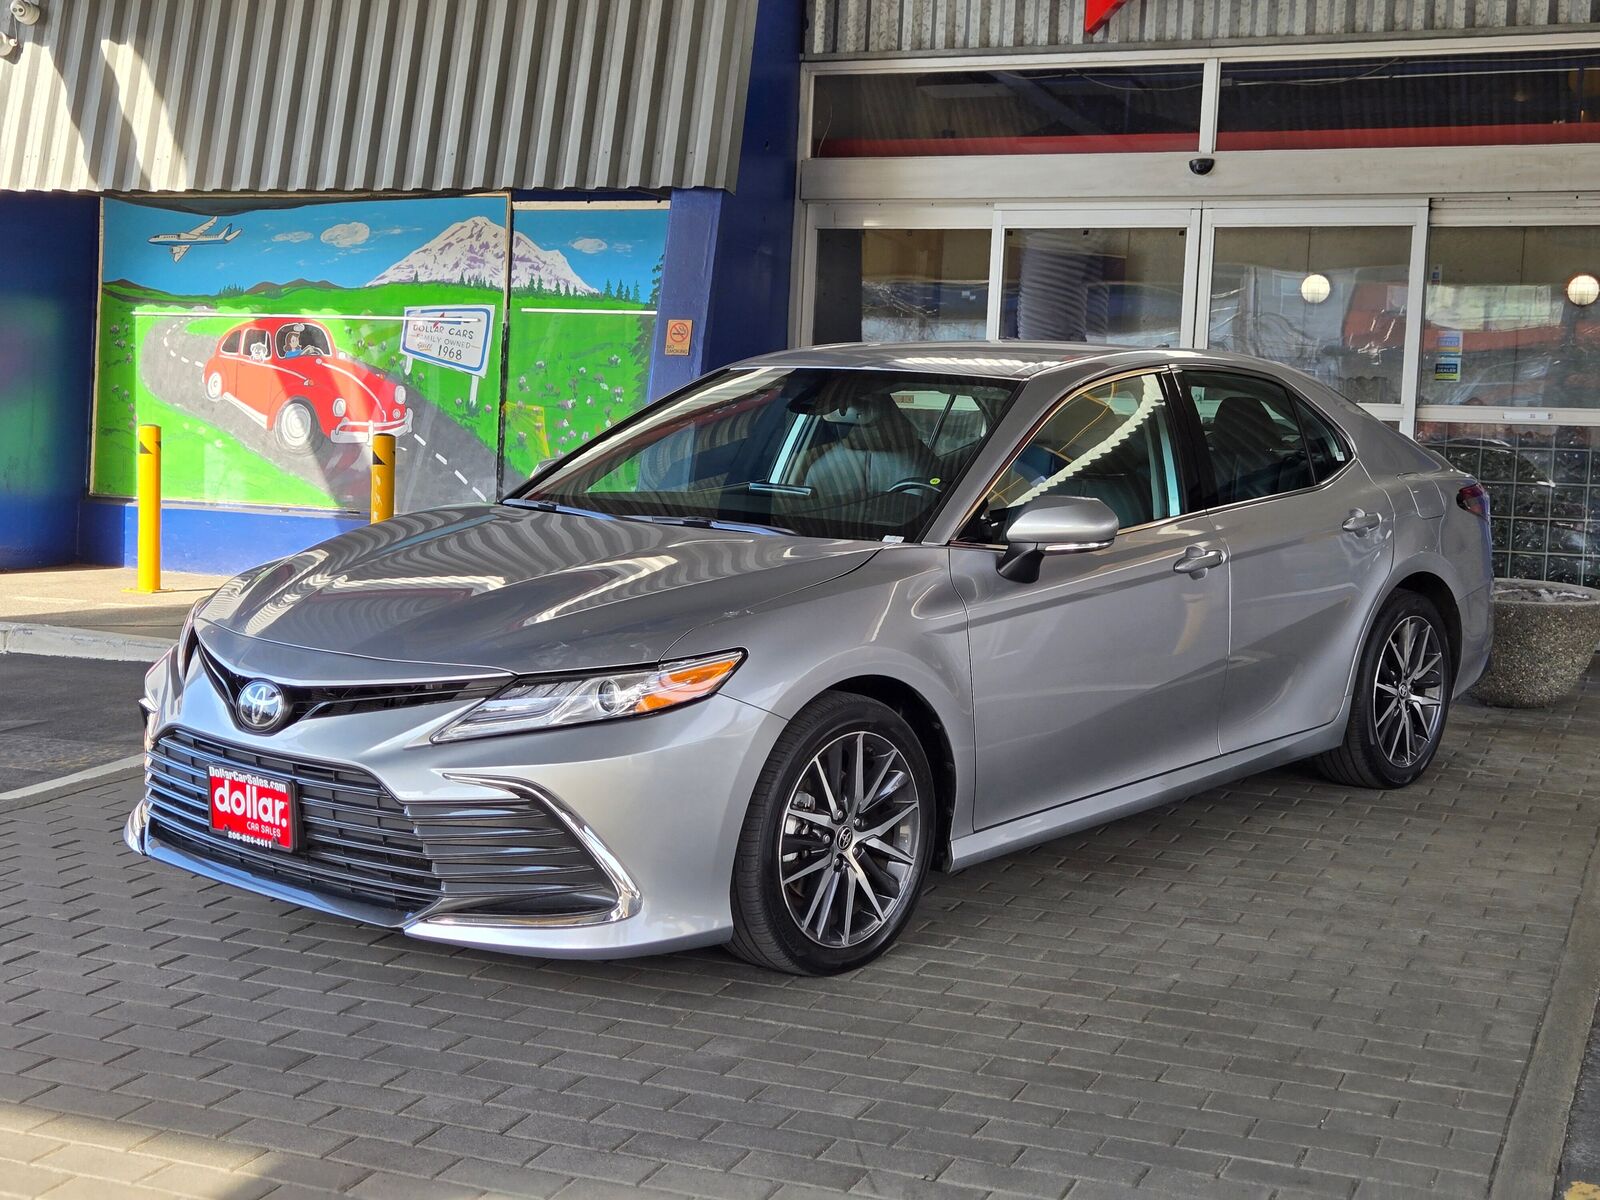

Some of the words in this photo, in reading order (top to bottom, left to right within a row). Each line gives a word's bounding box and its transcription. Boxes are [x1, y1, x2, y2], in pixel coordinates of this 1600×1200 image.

[413, 324, 444, 334] DOLLAR
[448, 327, 474, 340] CARS
[444, 338, 471, 349] OWNED
[438, 344, 462, 360] 1968
[208, 766, 287, 794] DollarCarSales.com
[246, 821, 260, 833] CAR
[260, 824, 281, 838] SALES
